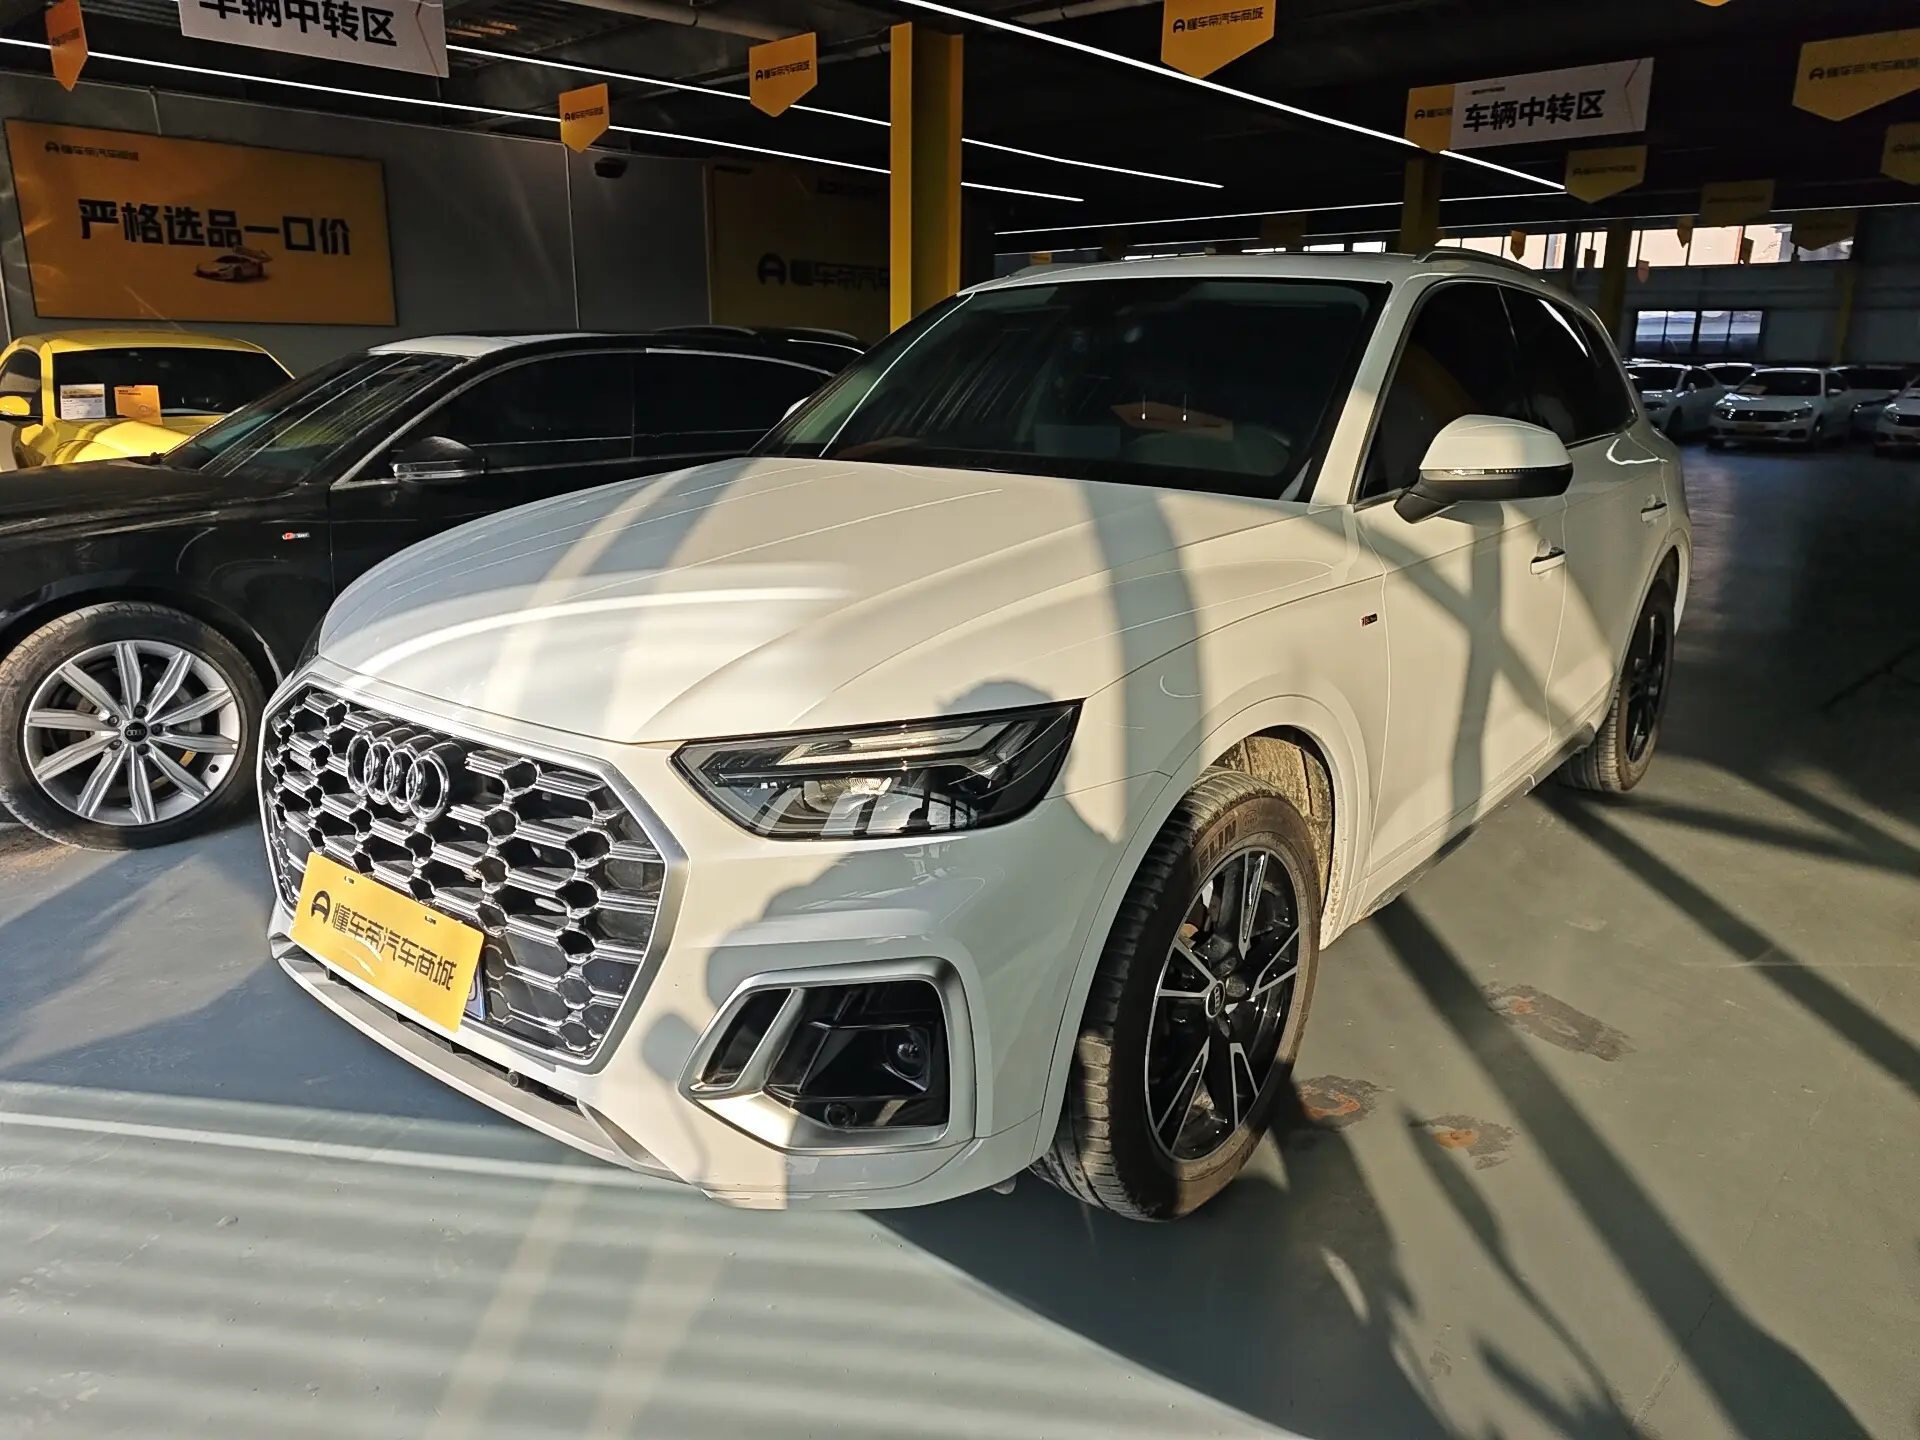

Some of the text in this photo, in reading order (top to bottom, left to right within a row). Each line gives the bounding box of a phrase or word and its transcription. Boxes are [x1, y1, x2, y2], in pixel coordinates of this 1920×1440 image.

[1462, 89, 1606, 133] 车辆中转区
[78, 198, 351, 256] 严格选品一口价
[332, 902, 458, 992] 懂车帝汽车商城
